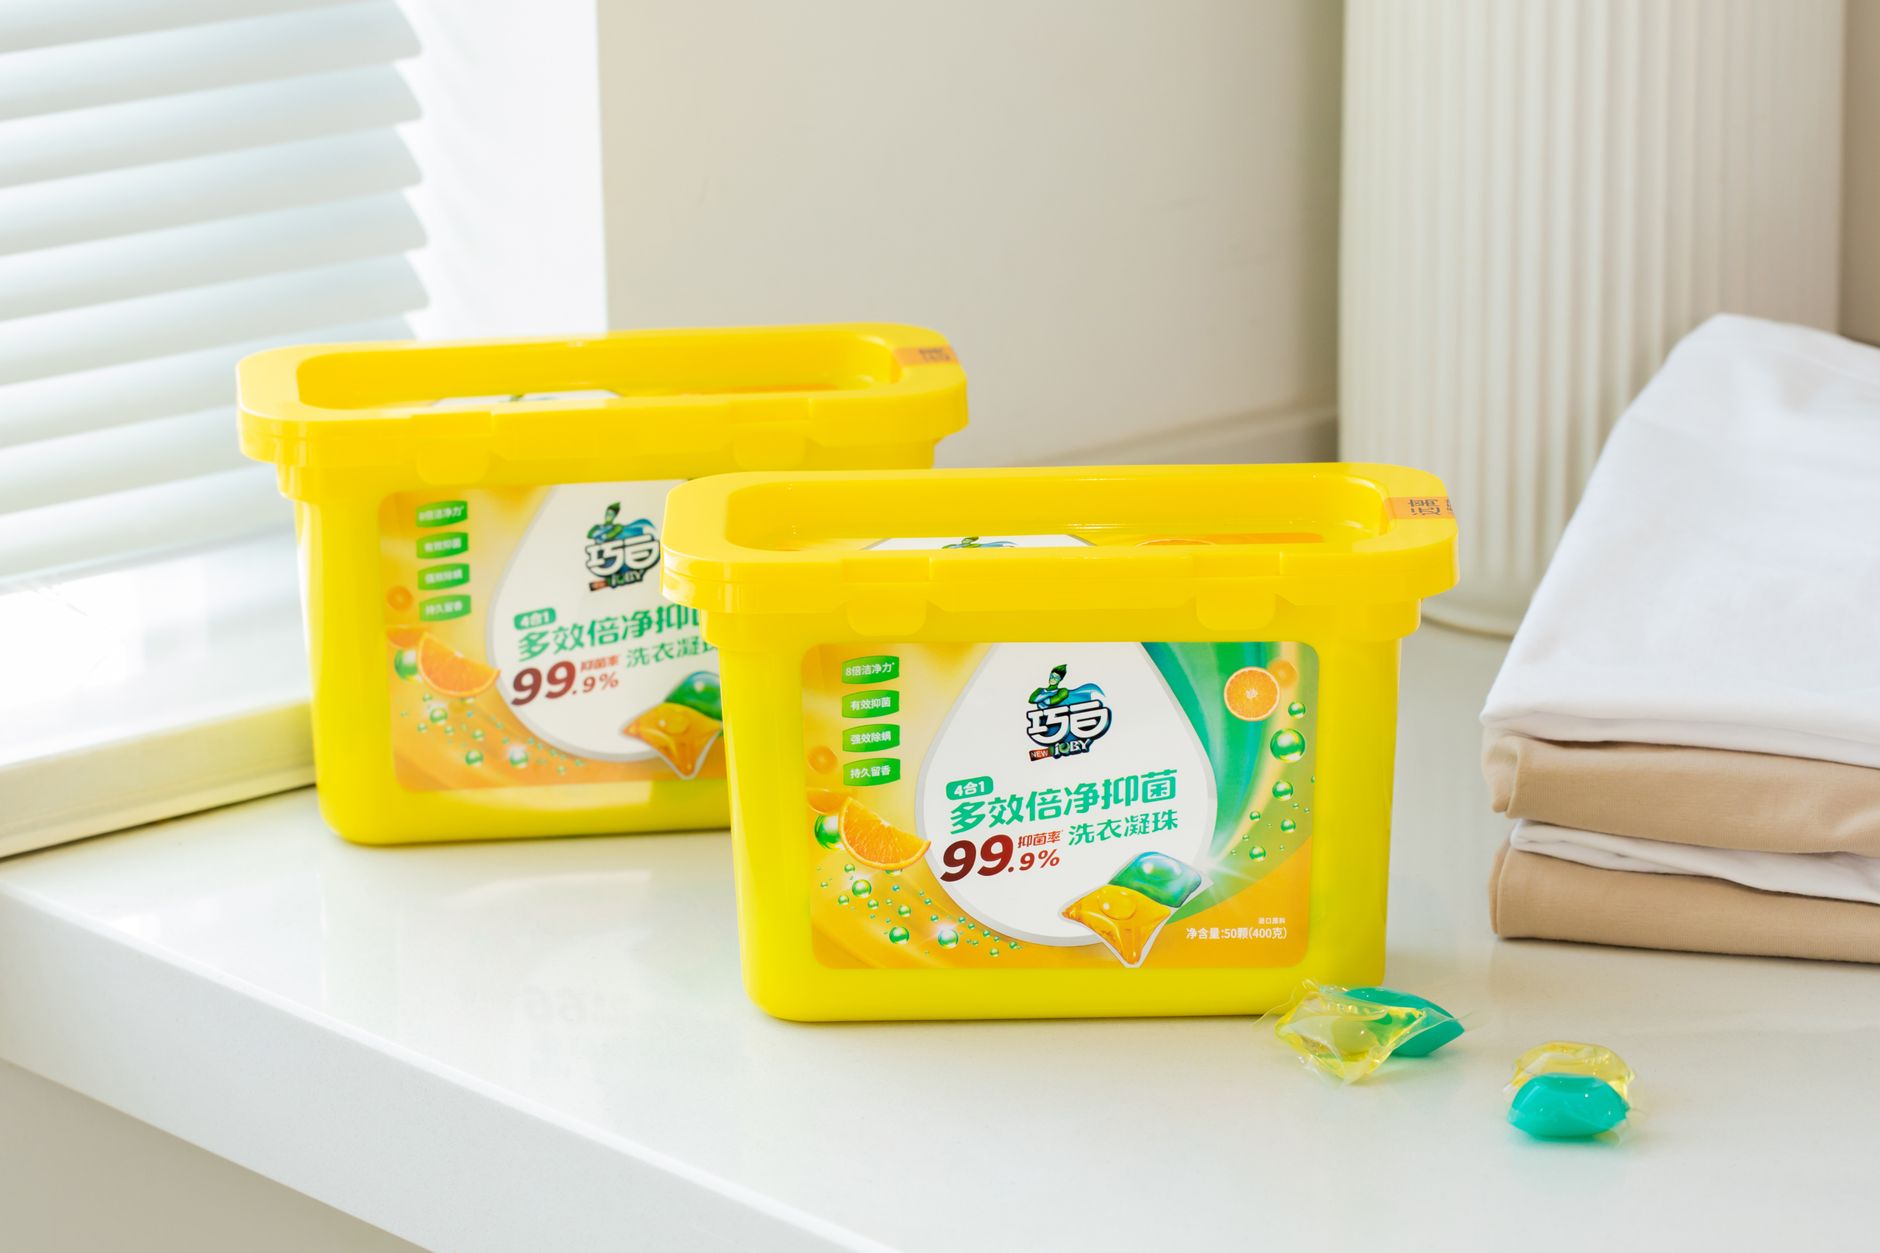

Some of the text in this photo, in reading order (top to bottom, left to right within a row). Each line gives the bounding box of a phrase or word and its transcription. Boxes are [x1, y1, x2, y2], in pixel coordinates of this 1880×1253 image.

[511, 660, 619, 706] 99.9%
[1030, 749, 1049, 759] NEW
[850, 765, 891, 779] 持久留香
[950, 769, 1178, 835] 多效倍净抑菌
[953, 780, 986, 797] 4合1
[1017, 830, 1062, 849] 抑菌率
[1068, 809, 1179, 846] 洗衣凝珠
[940, 834, 1060, 883] 99.9%
